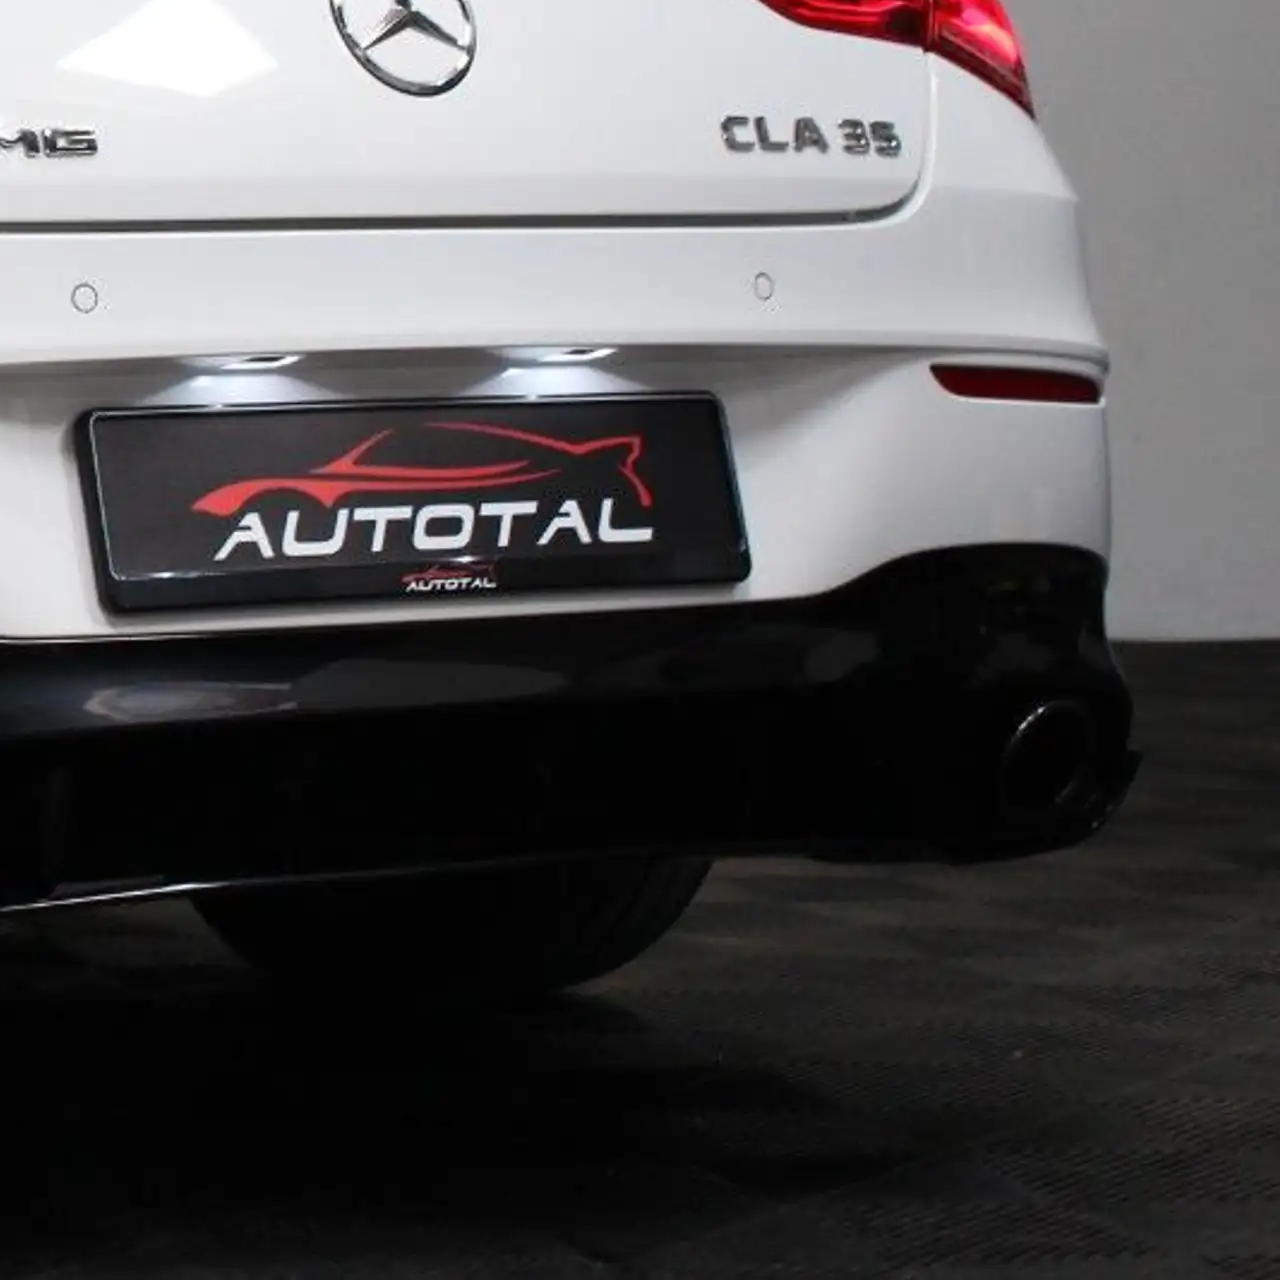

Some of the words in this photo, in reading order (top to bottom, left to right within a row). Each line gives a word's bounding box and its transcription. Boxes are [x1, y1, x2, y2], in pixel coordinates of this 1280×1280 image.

[720, 115, 830, 154] CLA
[837, 119, 903, 158] 35
[213, 497, 655, 562] AUTOTAL
[406, 576, 497, 593] AUTOTAL
